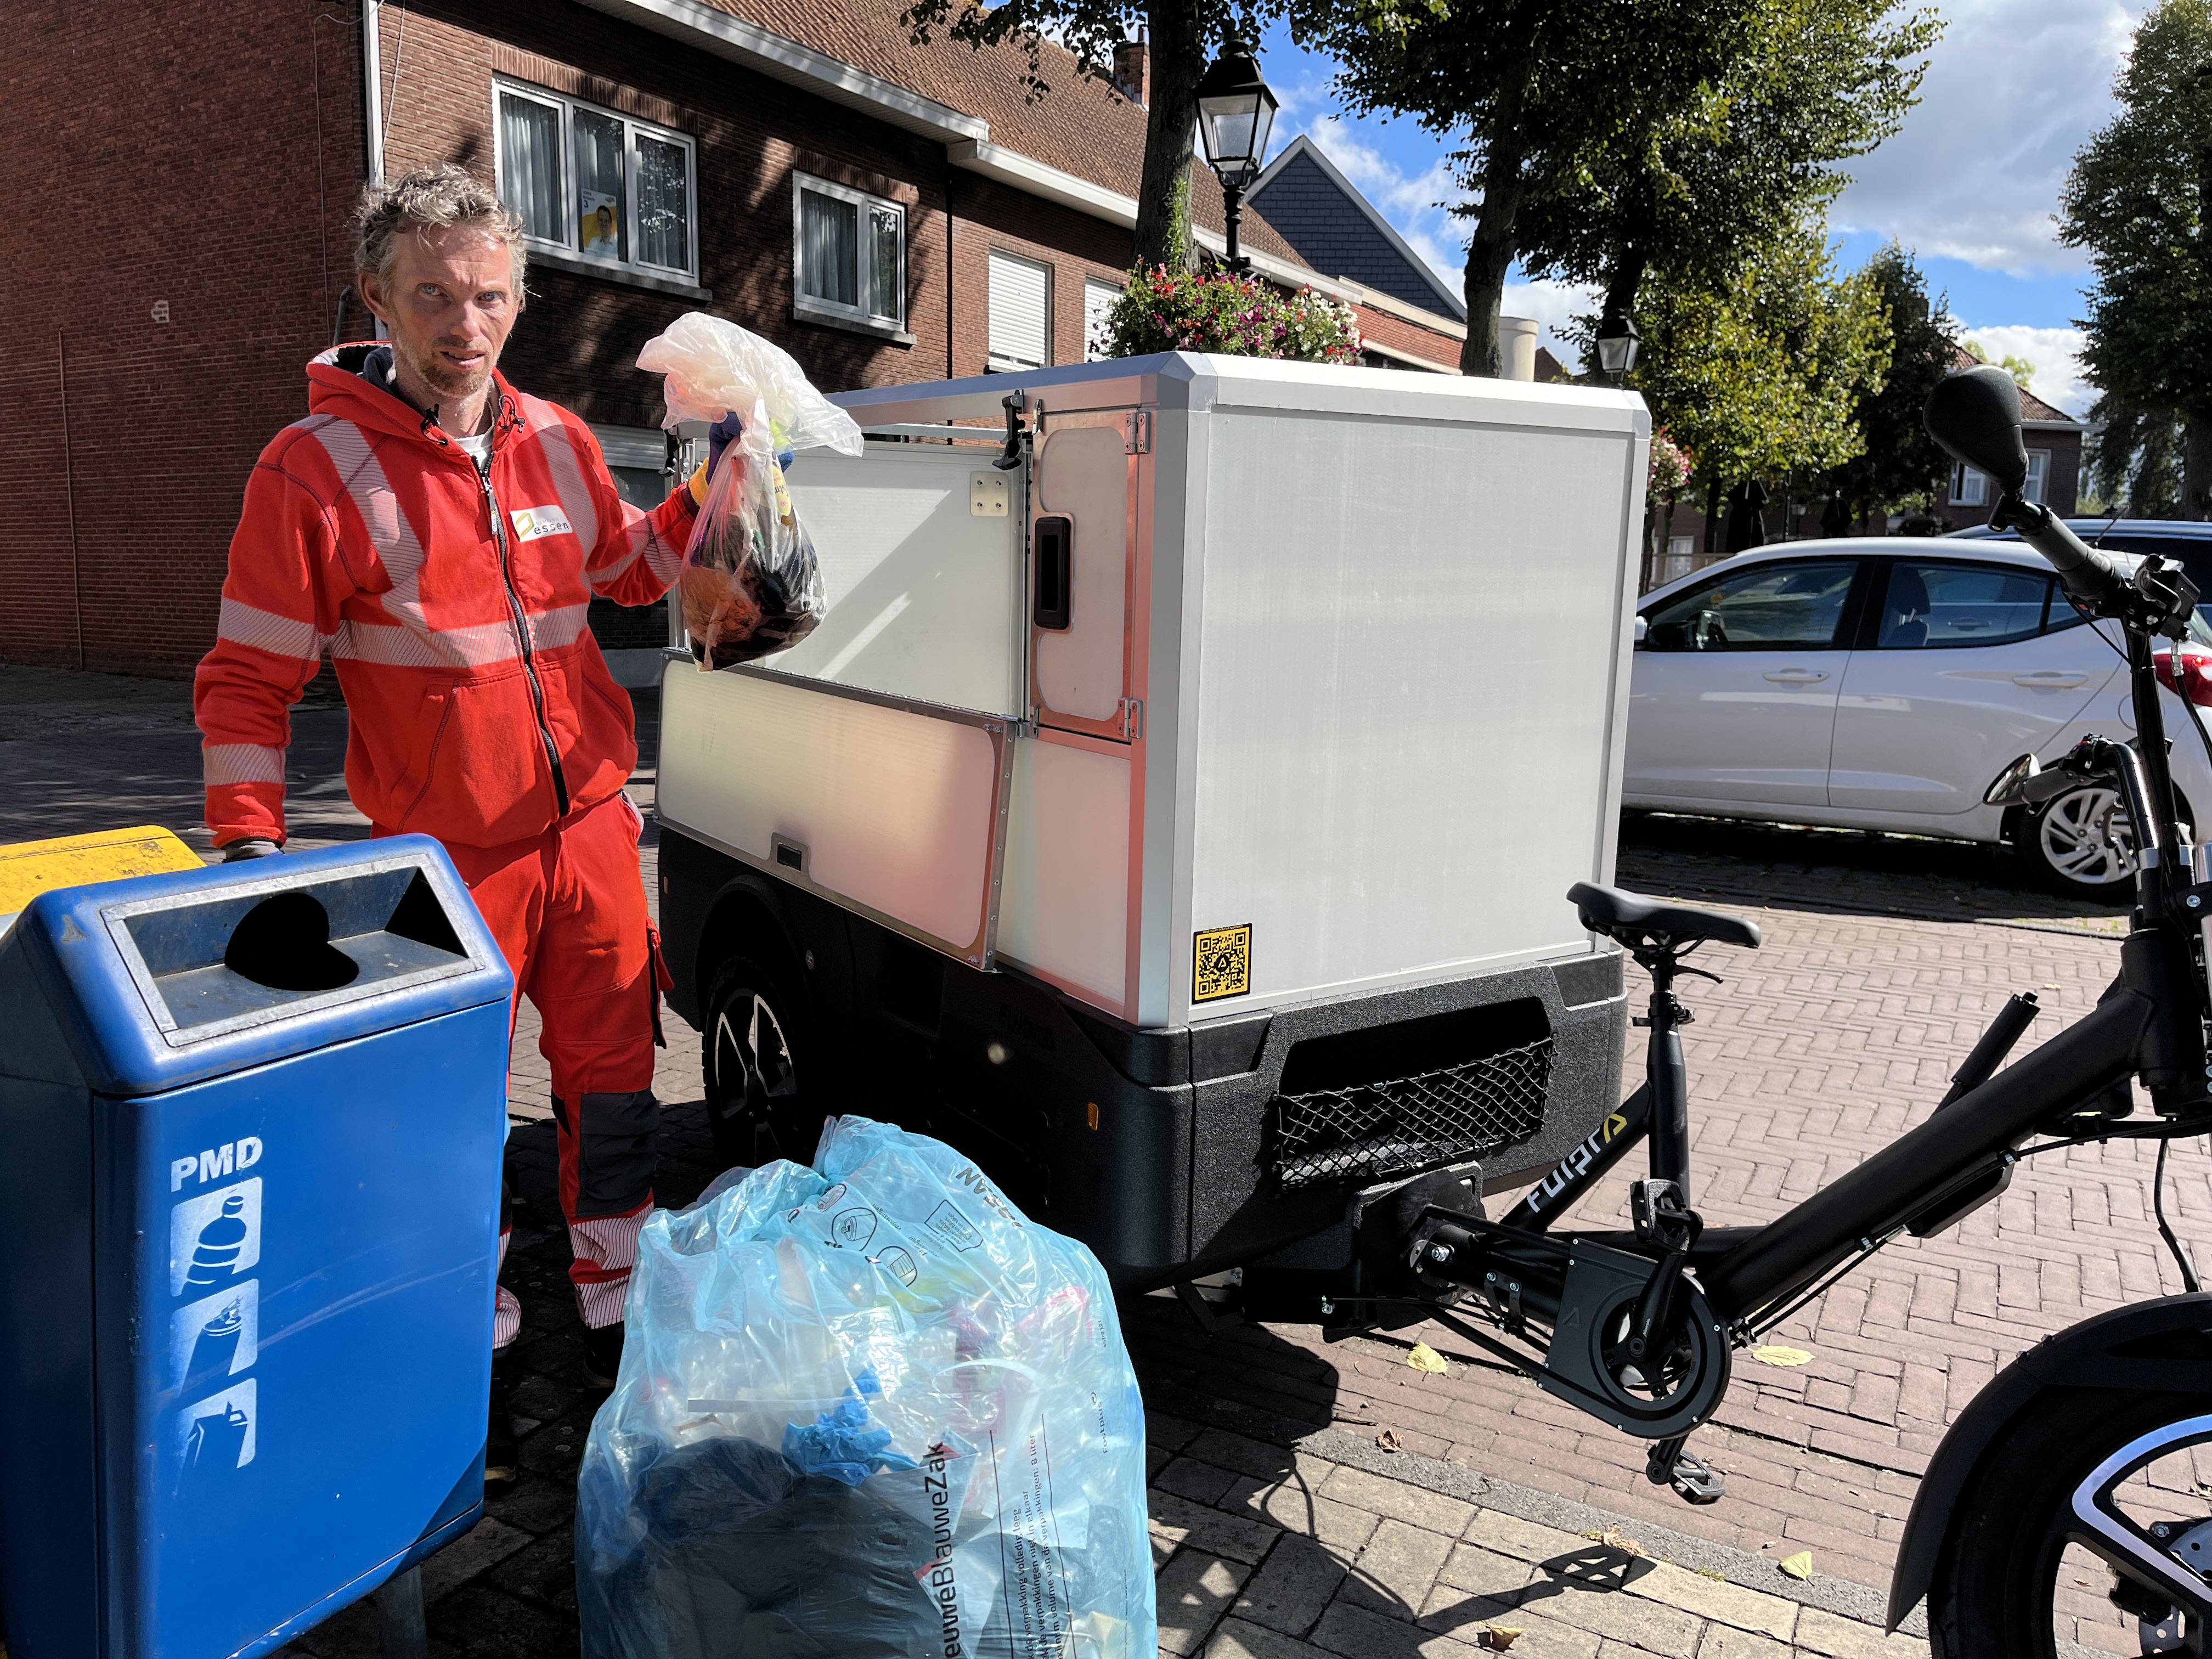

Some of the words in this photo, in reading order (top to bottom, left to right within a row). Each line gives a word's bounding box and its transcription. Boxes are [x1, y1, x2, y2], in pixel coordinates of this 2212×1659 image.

[583, 200, 589, 208] 3
[534, 522, 570, 534] essen
[170, 1136, 263, 1193] PMD
[1029, 1435, 1037, 1456] liter
[1022, 1491, 1033, 1522] elkaar
[1032, 1468, 1048, 1541] verpakkingen:
[1013, 1508, 1021, 1532] leeg
[1026, 1525, 1035, 1535] in
[1014, 1534, 1024, 1576] volledig
[1027, 1538, 1037, 1558] niet
[1042, 1543, 1049, 1555] de
[1044, 1558, 1052, 1577] van
[1018, 1578, 1031, 1635] verpakking
[1031, 1560, 1045, 1631] verpakkingen
[1047, 1579, 1057, 1619] volume
